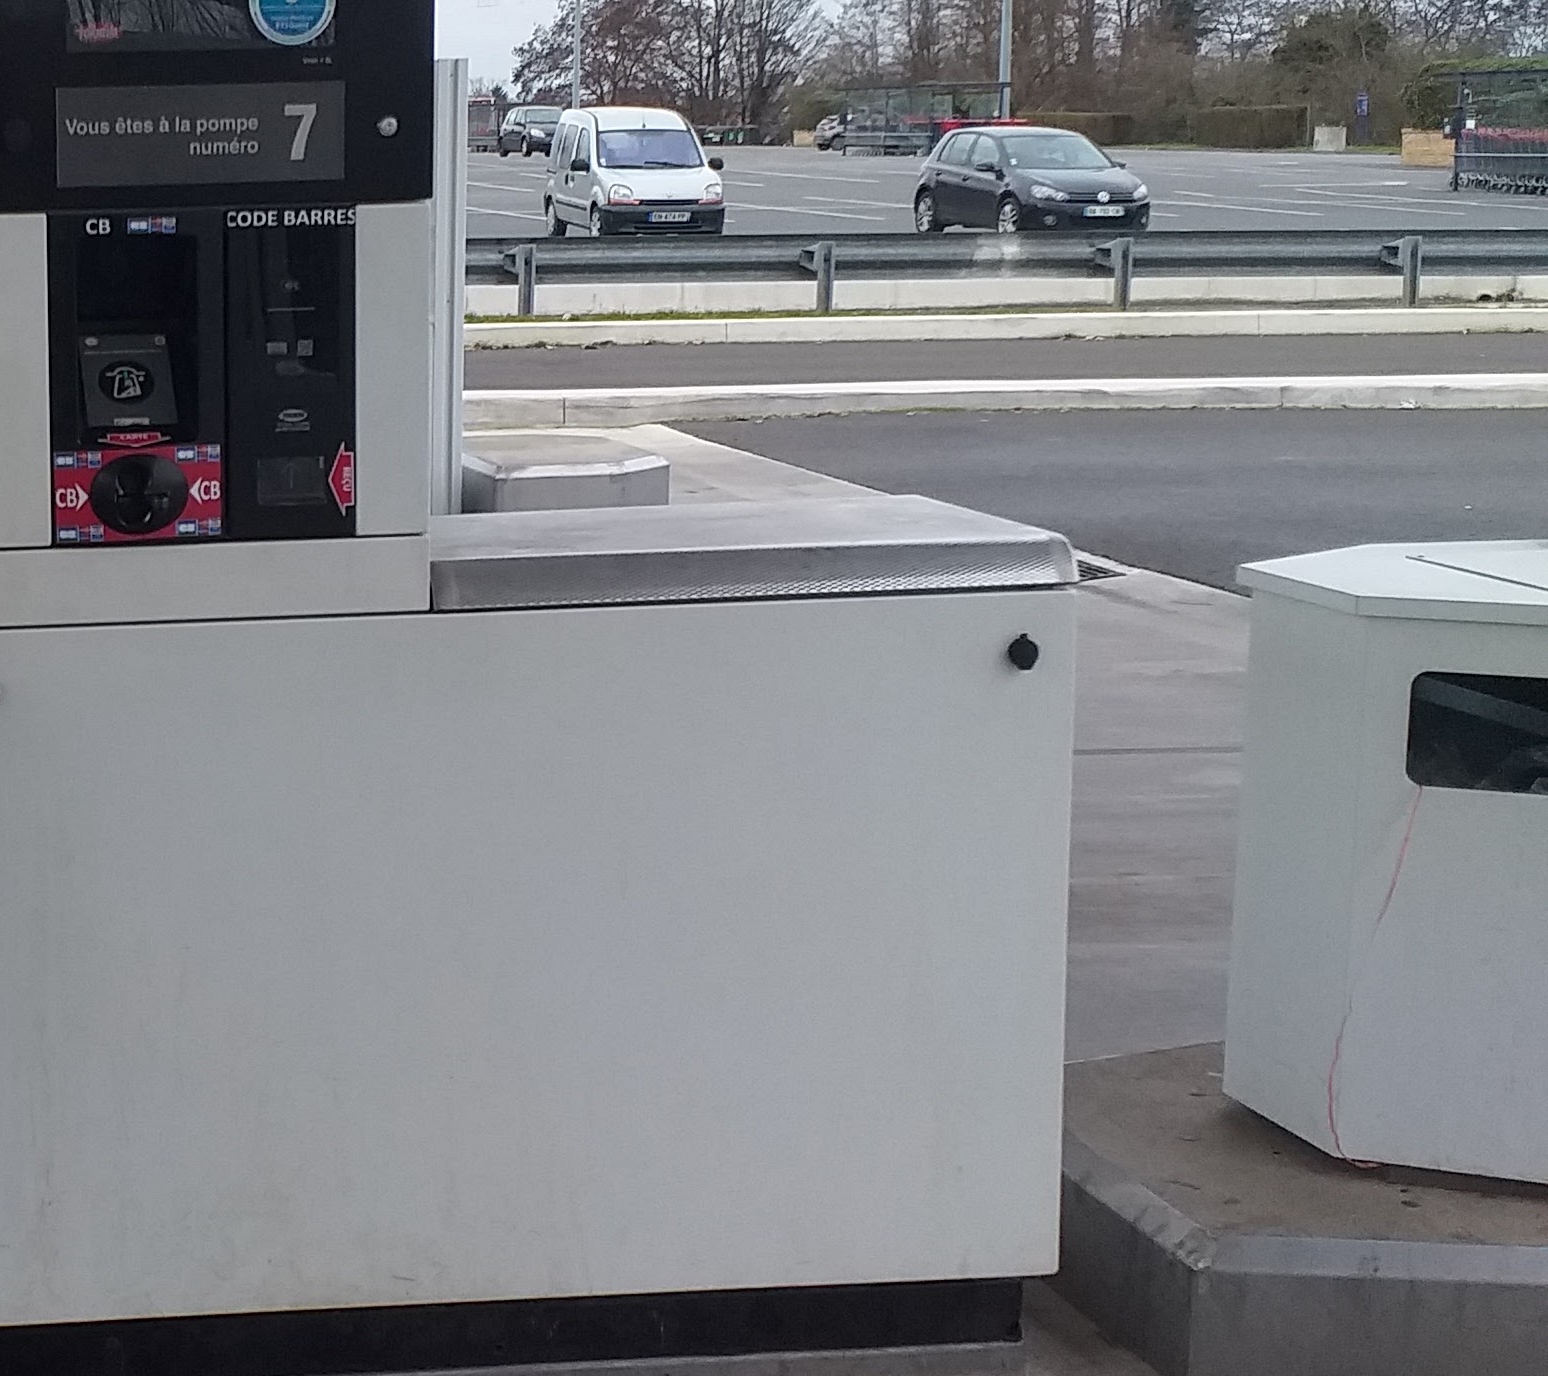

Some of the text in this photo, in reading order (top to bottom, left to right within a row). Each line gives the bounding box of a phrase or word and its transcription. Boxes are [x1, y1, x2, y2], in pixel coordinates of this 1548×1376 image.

[66, 115, 259, 136] Vous êtes à la pompe
[284, 103, 317, 160] 7
[189, 137, 259, 156] numéro
[85, 218, 111, 235] CB
[226, 208, 356, 227] CODE BARRES
[55, 488, 77, 508] CB
[200, 480, 221, 501] CB
